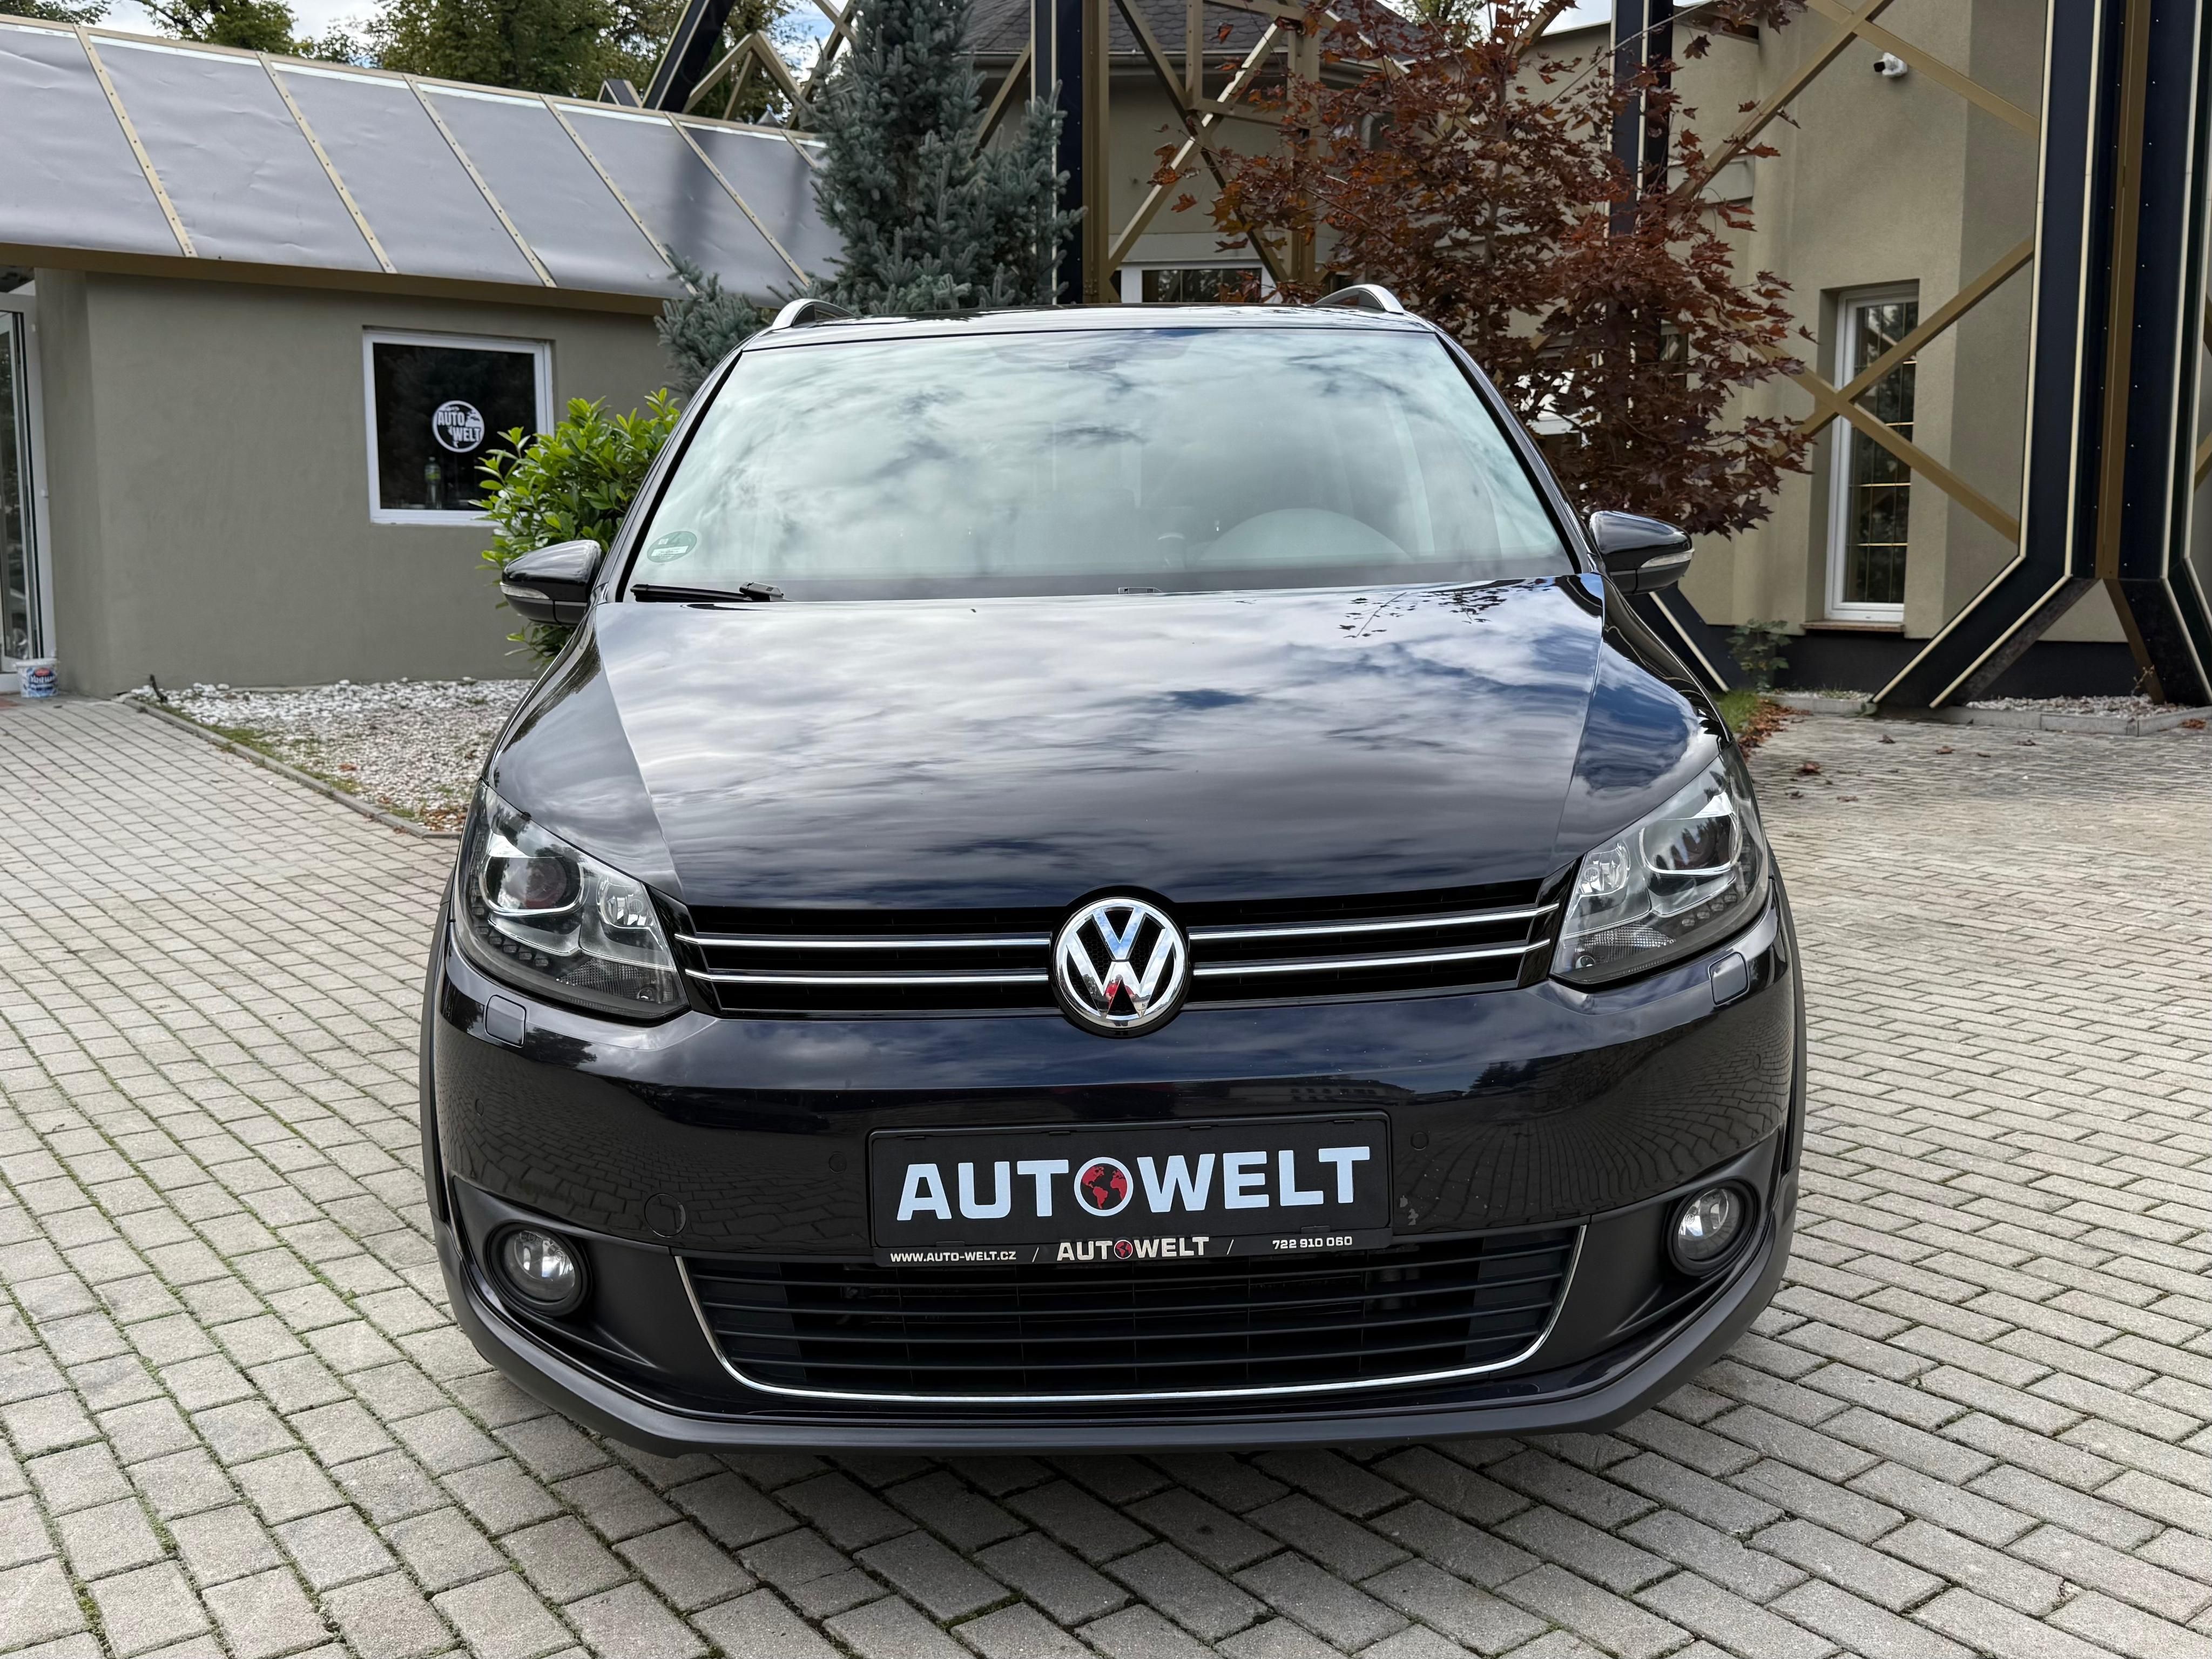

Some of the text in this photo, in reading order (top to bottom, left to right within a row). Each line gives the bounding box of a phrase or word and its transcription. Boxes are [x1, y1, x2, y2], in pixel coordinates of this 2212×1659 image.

[437, 411, 465, 426] AUTO
[453, 427, 481, 442] WELT
[1061, 903, 1181, 1022] VW
[896, 1146, 1371, 1221] AUTOWELT
[890, 1251, 1016, 1263] WWW.AUTO-WELT.CZ
[1056, 1236, 1209, 1262] AUTOWELT
[1272, 1240, 1297, 1250] 722
[1300, 1238, 1324, 1248] 910
[1326, 1236, 1353, 1247] 060
